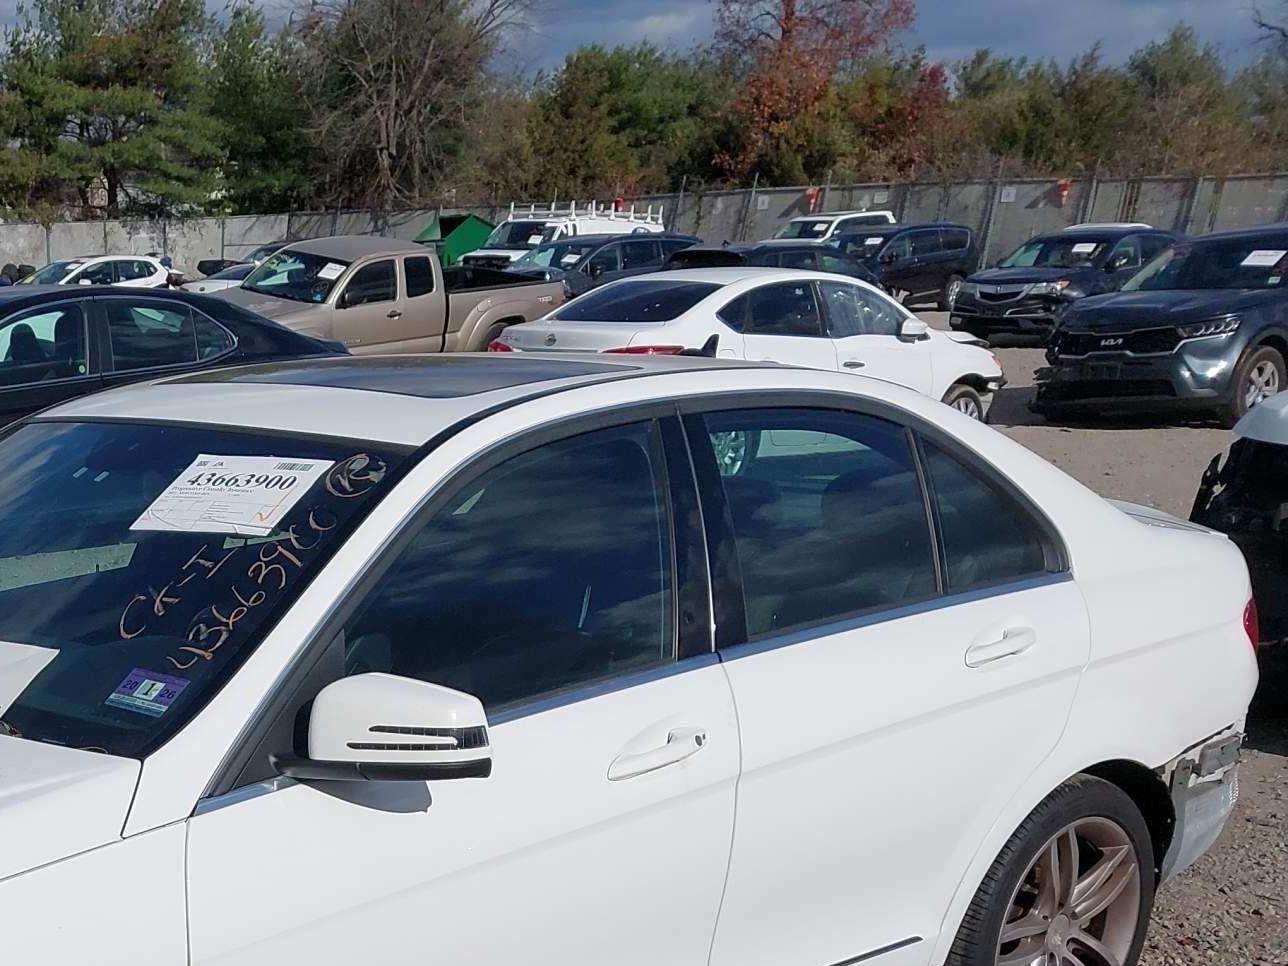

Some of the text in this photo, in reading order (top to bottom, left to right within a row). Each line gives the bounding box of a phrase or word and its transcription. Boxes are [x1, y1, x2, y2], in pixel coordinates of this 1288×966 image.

[186, 472, 297, 491] 43663900
[123, 680, 177, 700] 20 1 26
